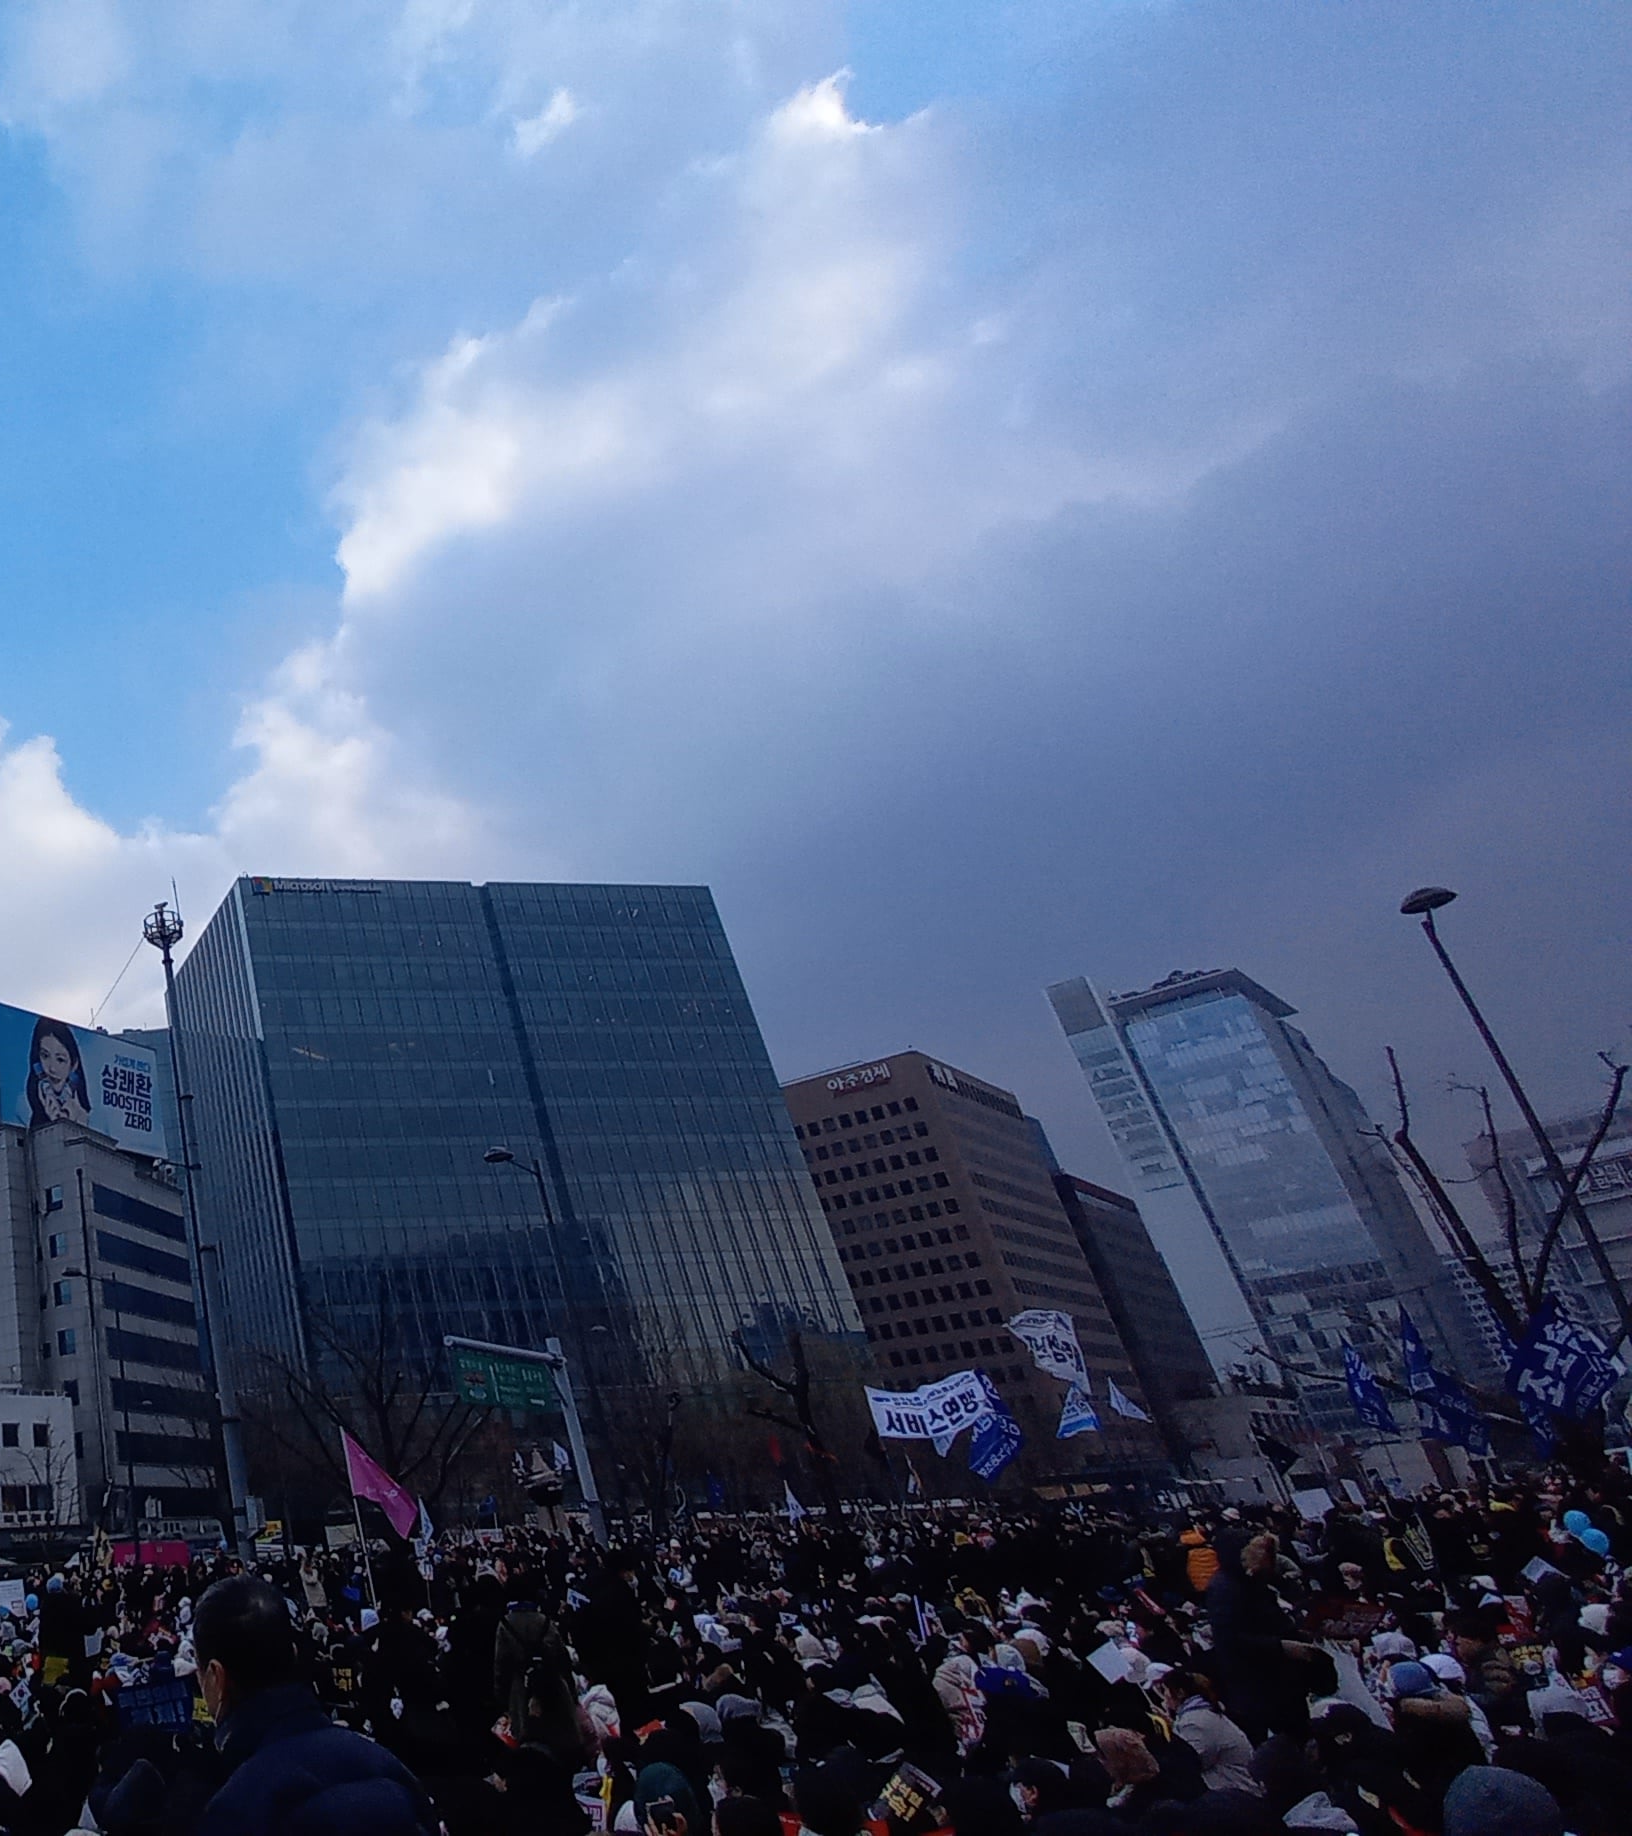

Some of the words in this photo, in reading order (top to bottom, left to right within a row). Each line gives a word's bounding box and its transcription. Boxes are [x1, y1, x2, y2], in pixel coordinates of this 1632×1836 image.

[102, 1064, 152, 1099] 상쾌환
[825, 1062, 891, 1092] 아주경제
[103, 1090, 151, 1116] BOOSTER
[125, 1112, 152, 1132] ZERO
[885, 1389, 979, 1436] 서비스연맹
